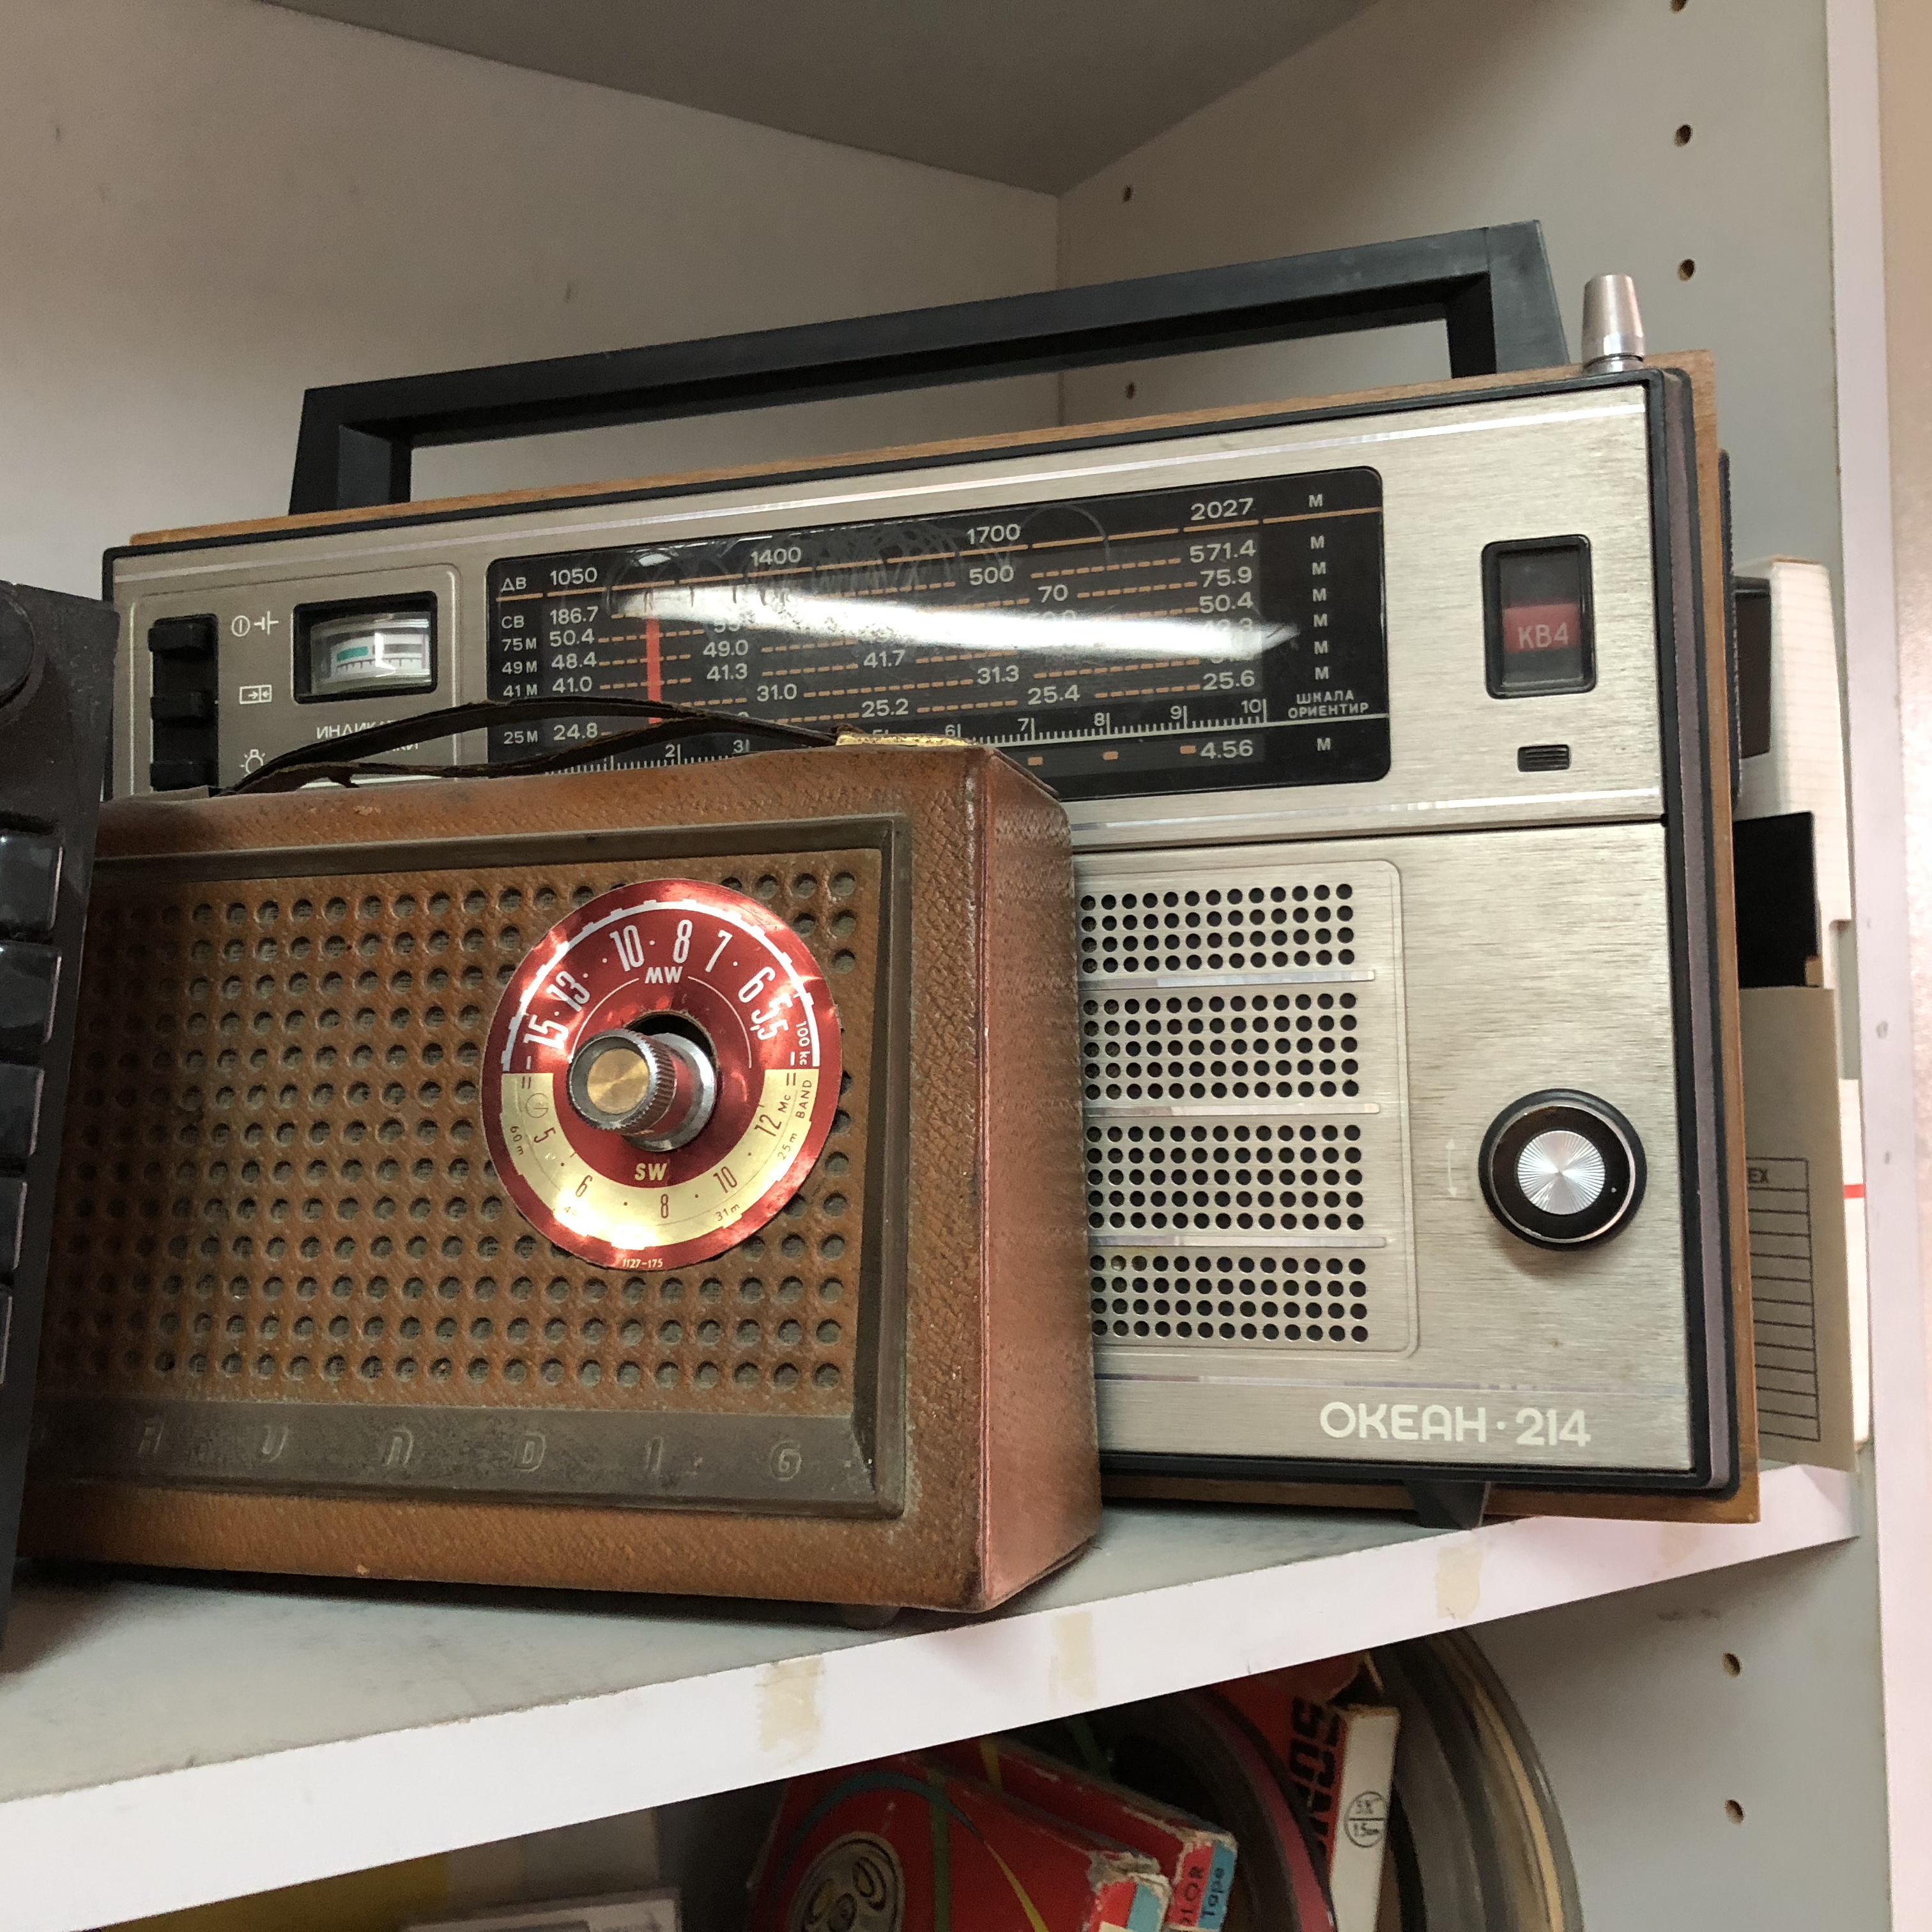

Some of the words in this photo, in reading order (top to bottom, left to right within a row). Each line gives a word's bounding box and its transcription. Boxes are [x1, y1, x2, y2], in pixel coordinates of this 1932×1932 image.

[549, 567, 598, 586] 1050
[750, 546, 803, 566] 1400
[966, 523, 1021, 545] 1700
[1190, 497, 1254, 521] 2027
[549, 606, 599, 625] 186.7
[969, 565, 1015, 586] 500
[1190, 539, 1257, 564] 571.4
[549, 629, 595, 648] 50.4
[1038, 584, 1069, 603] 70
[1200, 566, 1253, 588] 75.9
[551, 652, 597, 670] 48.4
[703, 640, 749, 657] 49.0
[1199, 592, 1254, 613] 50.4
[552, 676, 592, 693] 41.0
[707, 663, 748, 681] 41.3
[863, 650, 907, 668] 41.7
[756, 684, 798, 702] 31.0
[977, 665, 1020, 685] 31.3
[553, 723, 599, 740] 24.8
[861, 698, 909, 718] 25.2
[1027, 685, 1081, 705] 25.4
[1202, 670, 1256, 691] 25.6
[1287, 702, 1369, 719] ОРИЕНТИР
[1296, 689, 1355, 704] ШКАЛА
[665, 744, 676, 758] 2
[733, 740, 744, 753] 3
[1017, 718, 1029, 731] 7
[1094, 713, 1105, 726] 8
[1170, 706, 1182, 720] 9
[1241, 699, 1261, 714] 10
[1199, 739, 1254, 759] 4.56
[610, 924, 645, 972] 10
[673, 919, 693, 964] 8
[705, 930, 733, 973] 7
[546, 970, 590, 1012] 13
[645, 966, 683, 985] MW
[738, 966, 776, 1003] 6
[524, 1012, 569, 1050] 15
[796, 1020, 810, 1047] 100
[795, 1079, 813, 1119] BAND
[533, 1126, 556, 1144] 5
[575, 1174, 594, 1198] 6
[660, 1194, 670, 1218] 8
[712, 1165, 738, 1193] 10
[754, 1114, 782, 1137] 12
[778, 1094, 792, 1113] Mc
[634, 1162, 668, 1182] SW
[622, 1257, 664, 1269] 1127-175
[29, 1413, 803, 1482] RUNDIG
